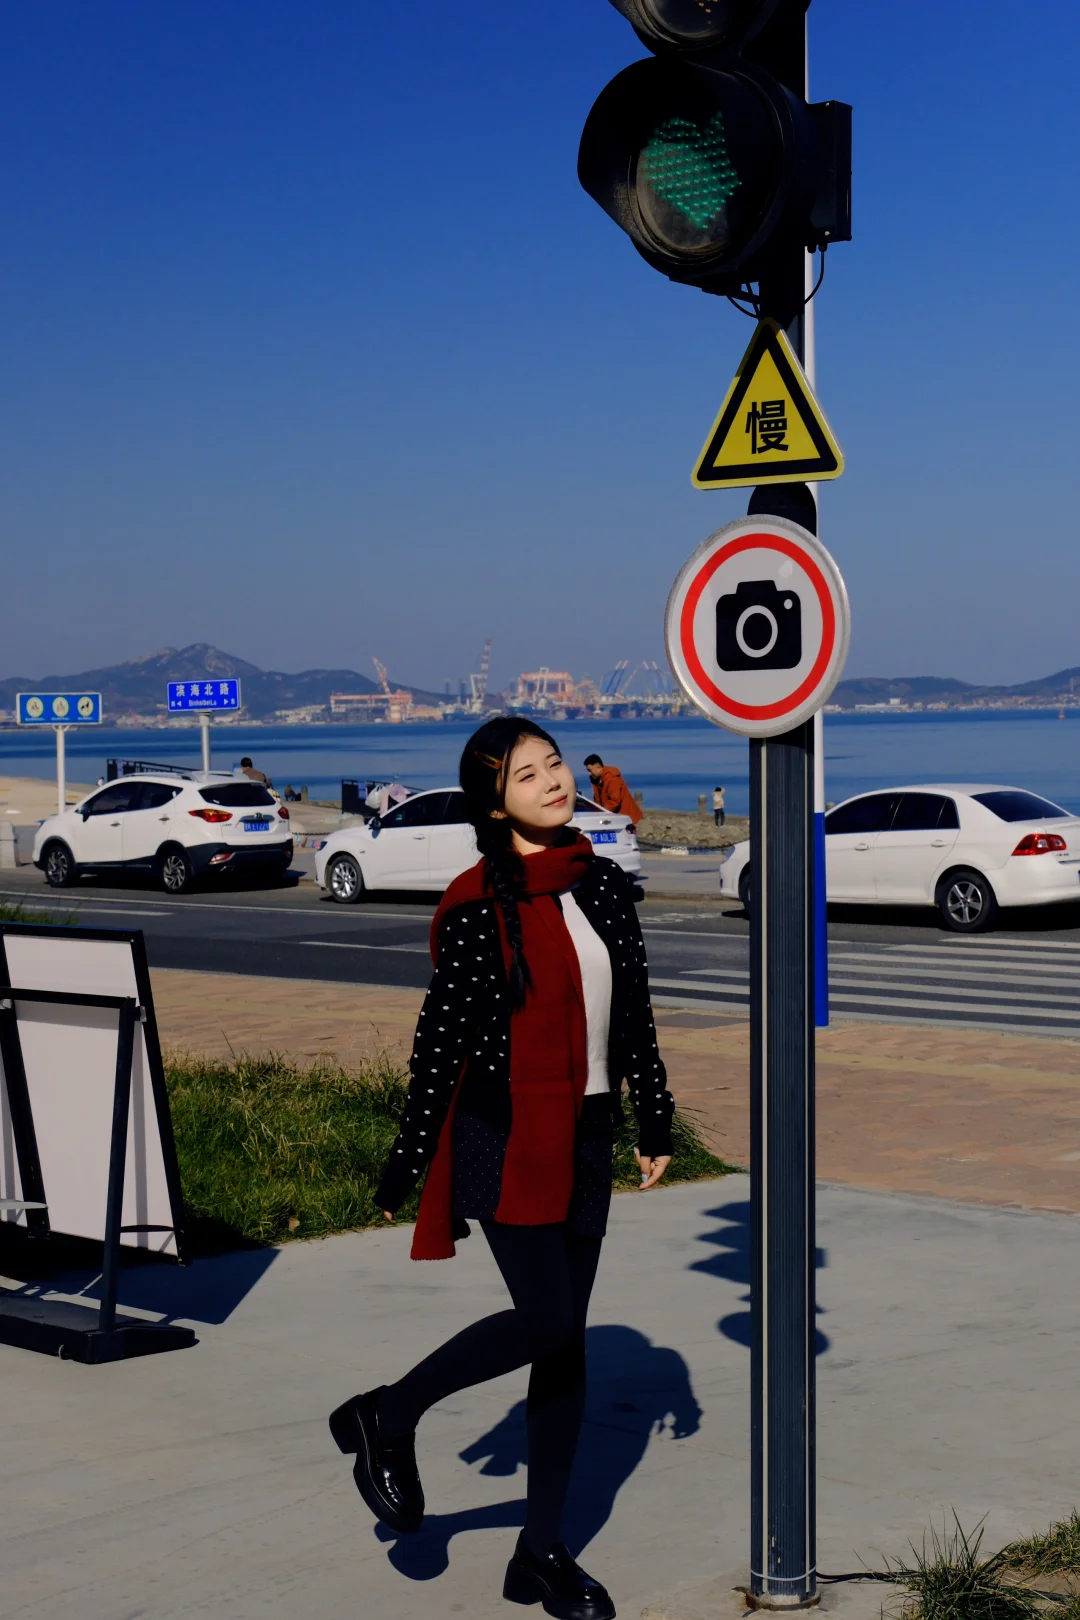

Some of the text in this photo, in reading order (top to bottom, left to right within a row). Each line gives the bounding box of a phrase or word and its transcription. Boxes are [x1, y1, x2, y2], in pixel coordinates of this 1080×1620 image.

[745, 400, 789, 454] 慢
[176, 683, 229, 697] 滨海北路
